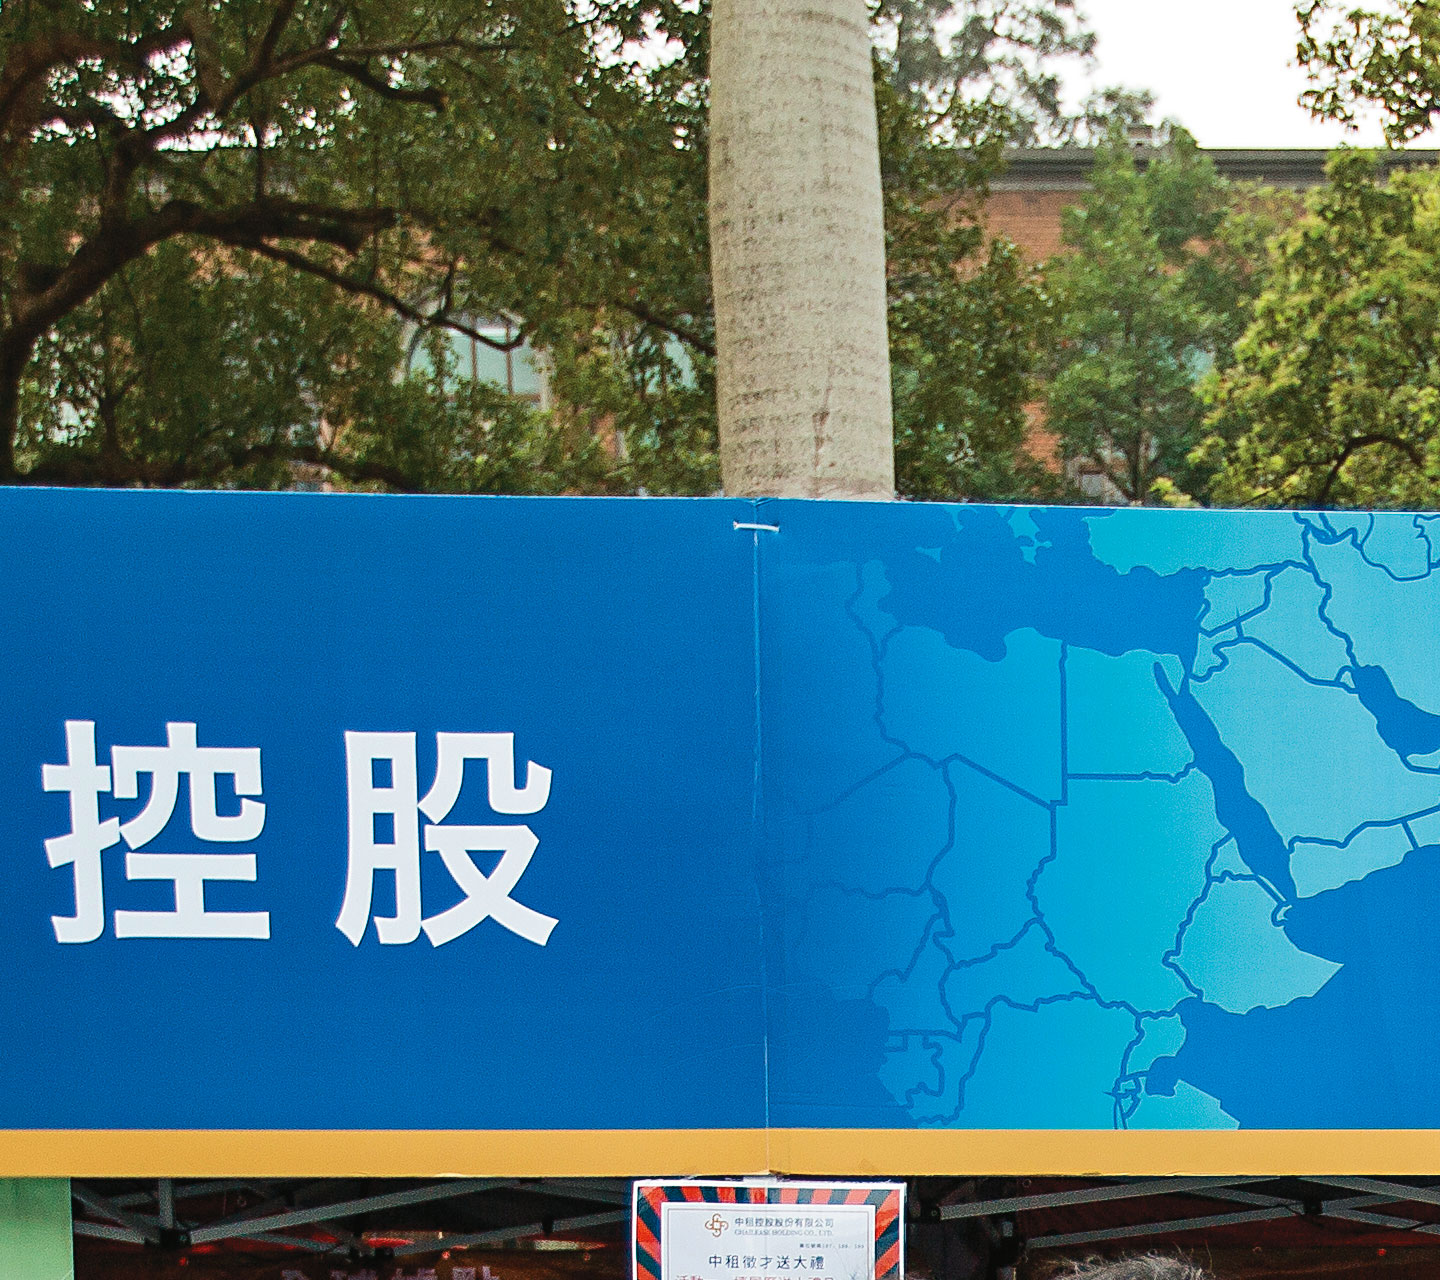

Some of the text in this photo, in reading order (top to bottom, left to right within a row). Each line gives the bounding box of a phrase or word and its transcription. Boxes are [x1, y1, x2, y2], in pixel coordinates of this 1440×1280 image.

[709, 1255, 825, 1270] 中租徵才送大禮
